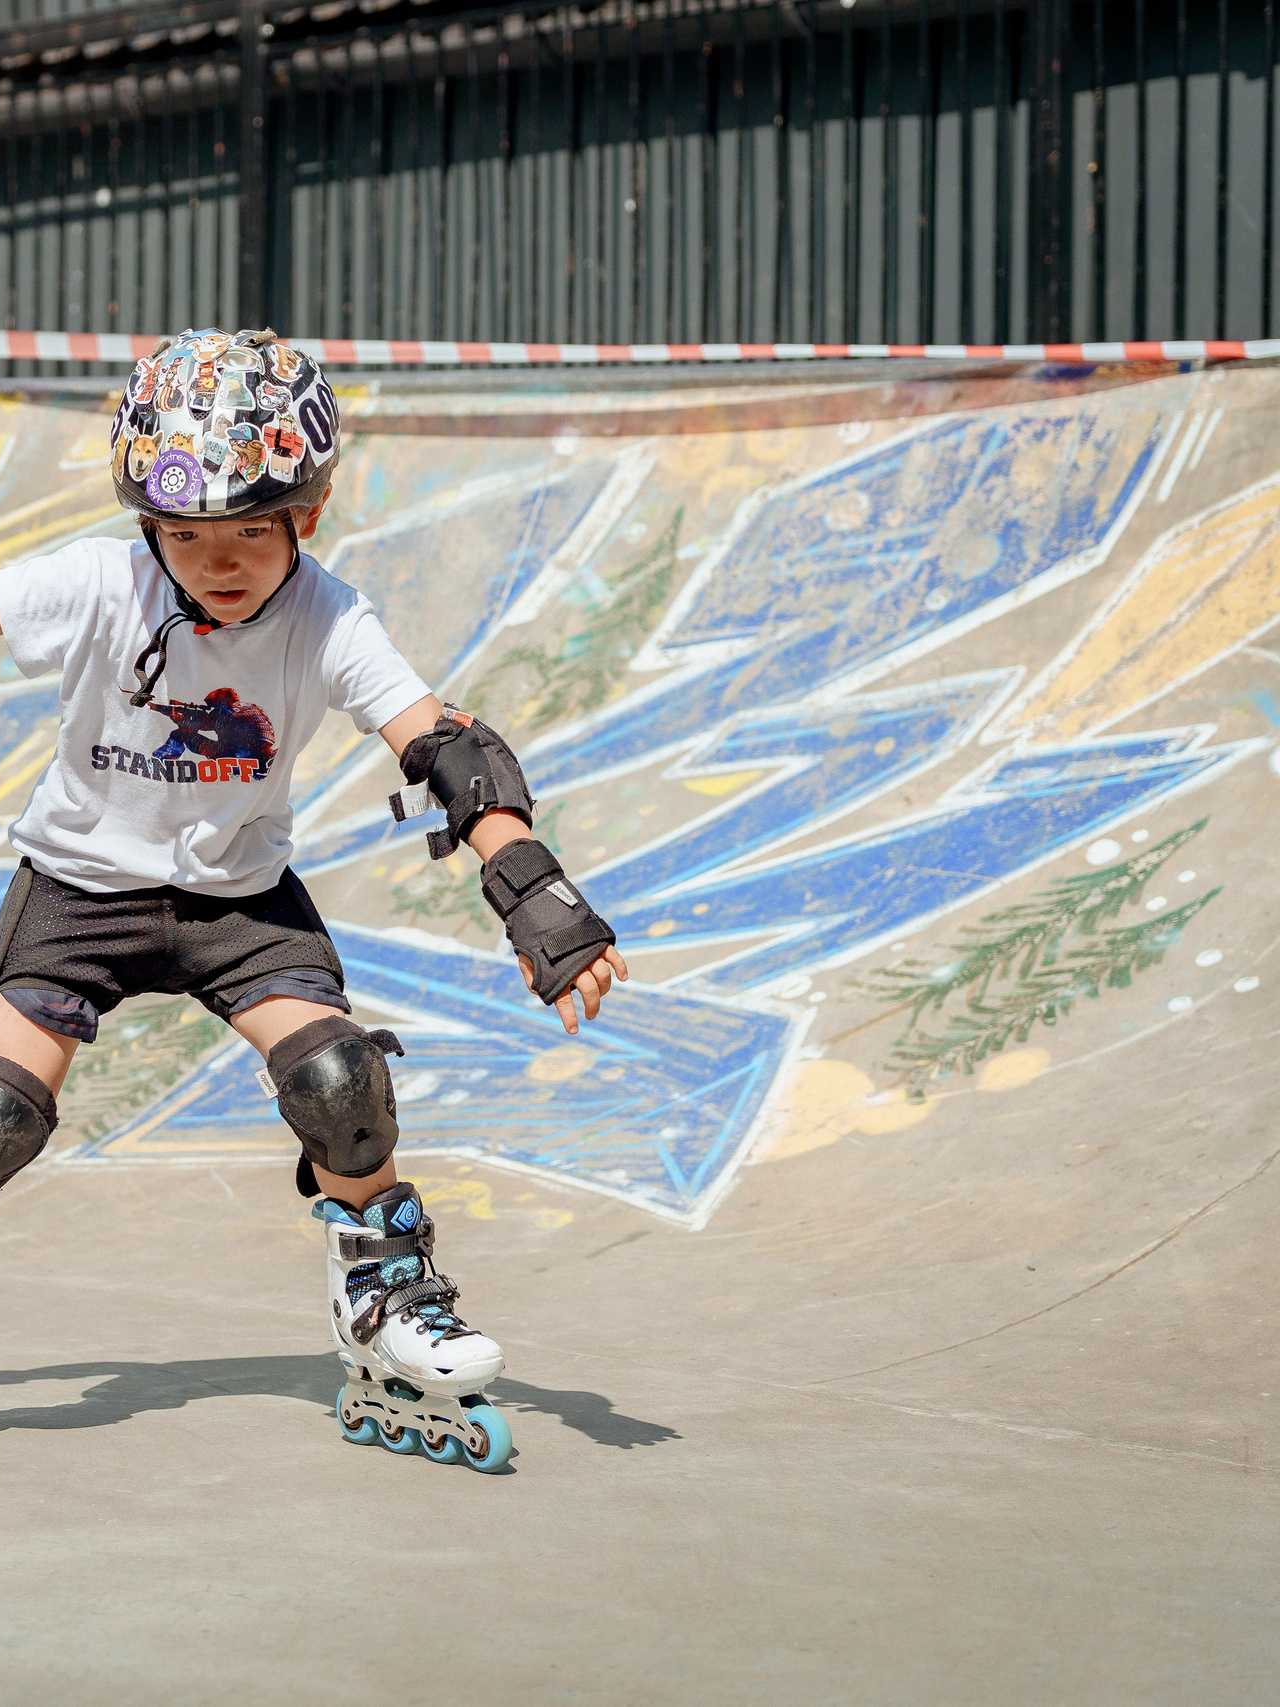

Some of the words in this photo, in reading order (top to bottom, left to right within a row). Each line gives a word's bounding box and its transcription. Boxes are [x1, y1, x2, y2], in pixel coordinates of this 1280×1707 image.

[299, 374, 340, 454] 00
[149, 471, 175, 509] OneWhe
[159, 451, 194, 468] Extreme
[185, 467, 201, 499] School
[91, 744, 259, 783] STANDOFF
[553, 884, 572, 900] oxelo
[260, 1073, 274, 1093] oxelo
